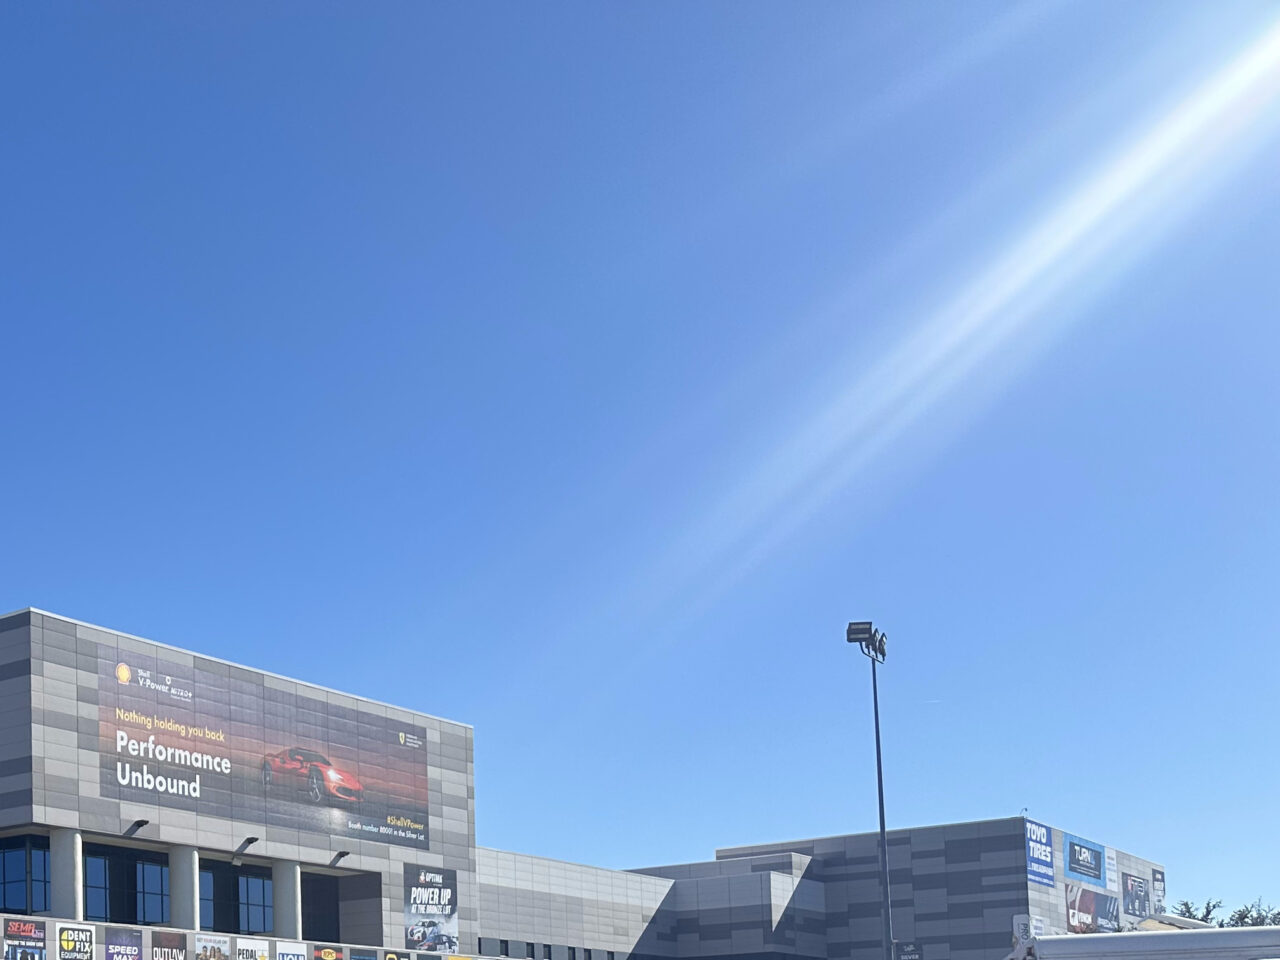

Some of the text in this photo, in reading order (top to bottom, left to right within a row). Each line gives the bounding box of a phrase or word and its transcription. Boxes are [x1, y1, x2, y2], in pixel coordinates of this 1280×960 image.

[138, 669, 150, 678] Shell
[138, 677, 169, 693] V-Power
[115, 707, 225, 742] Nothing holding you back
[116, 730, 231, 774] Performance
[116, 762, 201, 798] Unbound
[1026, 822, 1047, 844] TOYO
[1029, 840, 1051, 862] TIRES
[410, 887, 451, 905] POWER UP
[417, 904, 426, 914] THE
[68, 930, 90, 941] DENT
[76, 941, 90, 952] FIX
[108, 944, 138, 955] SPEED
[61, 951, 91, 960] EQUIPMENT
[238, 948, 257, 960] PEDAL
